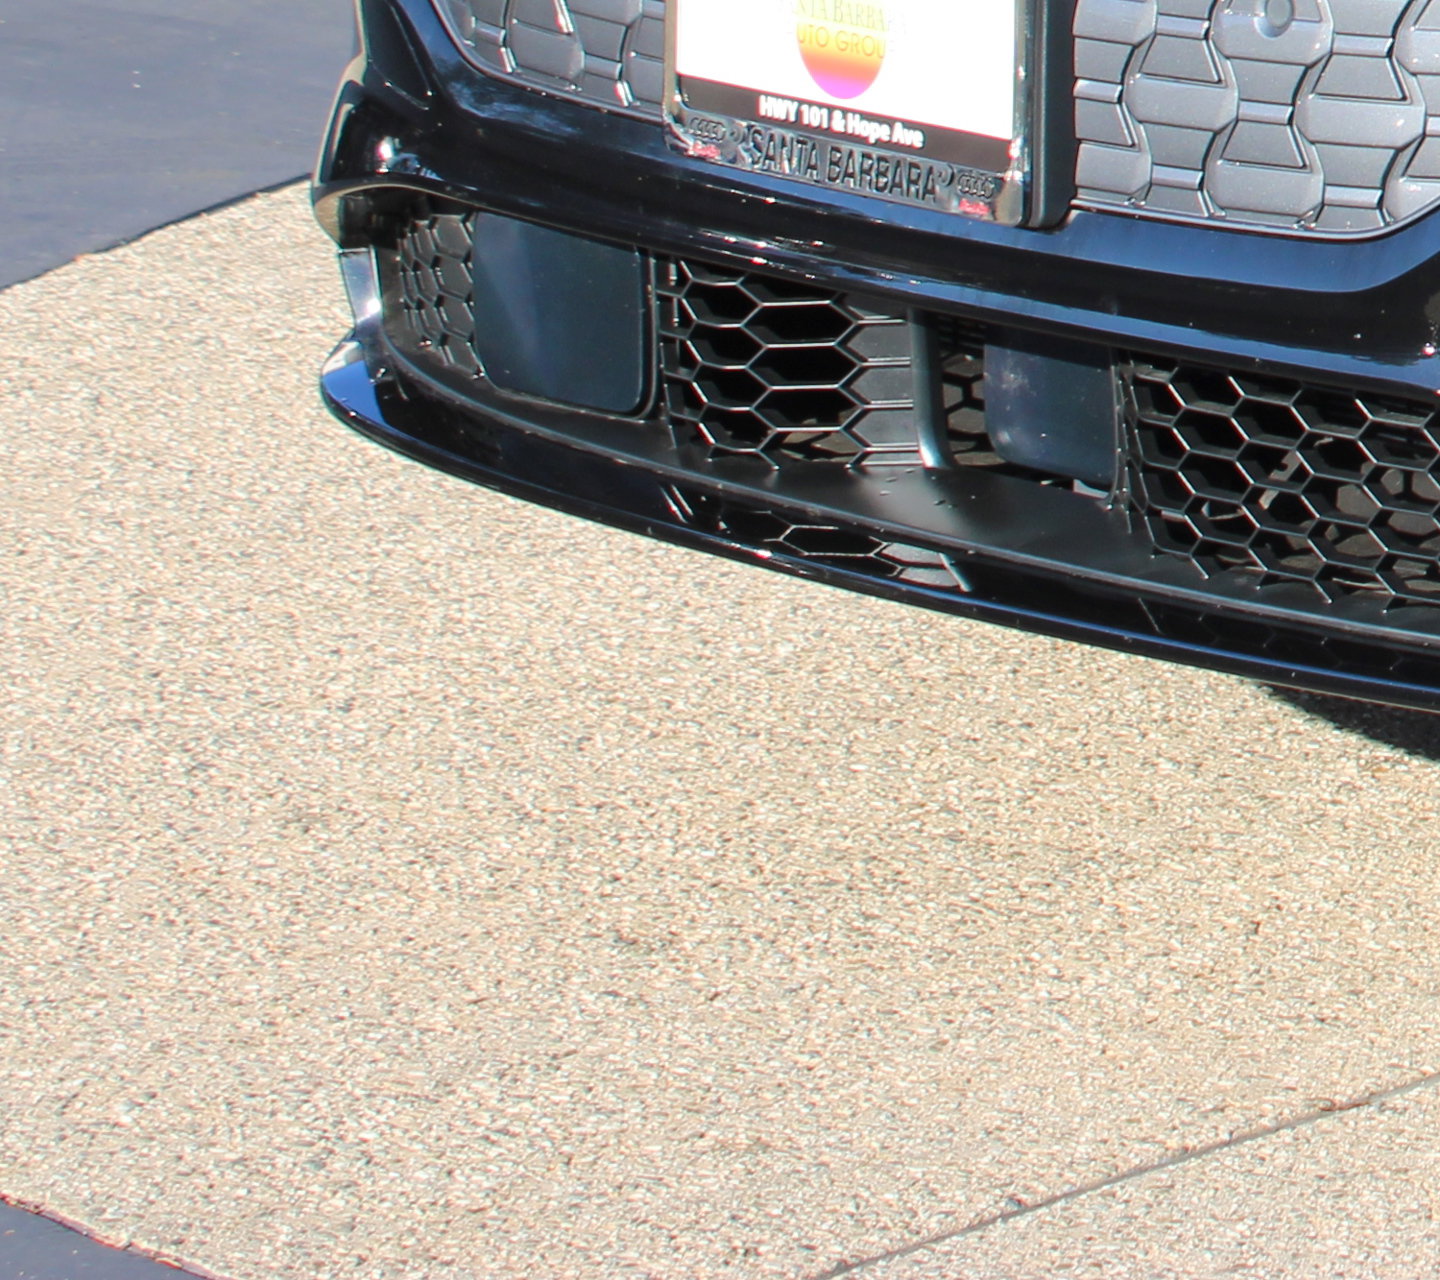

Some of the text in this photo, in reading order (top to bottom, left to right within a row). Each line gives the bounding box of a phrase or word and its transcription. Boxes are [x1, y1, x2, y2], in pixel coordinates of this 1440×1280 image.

[834, 28, 895, 60] GROU
[759, 95, 924, 148] HWY 101 & Hope Ave
[749, 126, 937, 203] SANTA BARBARA
